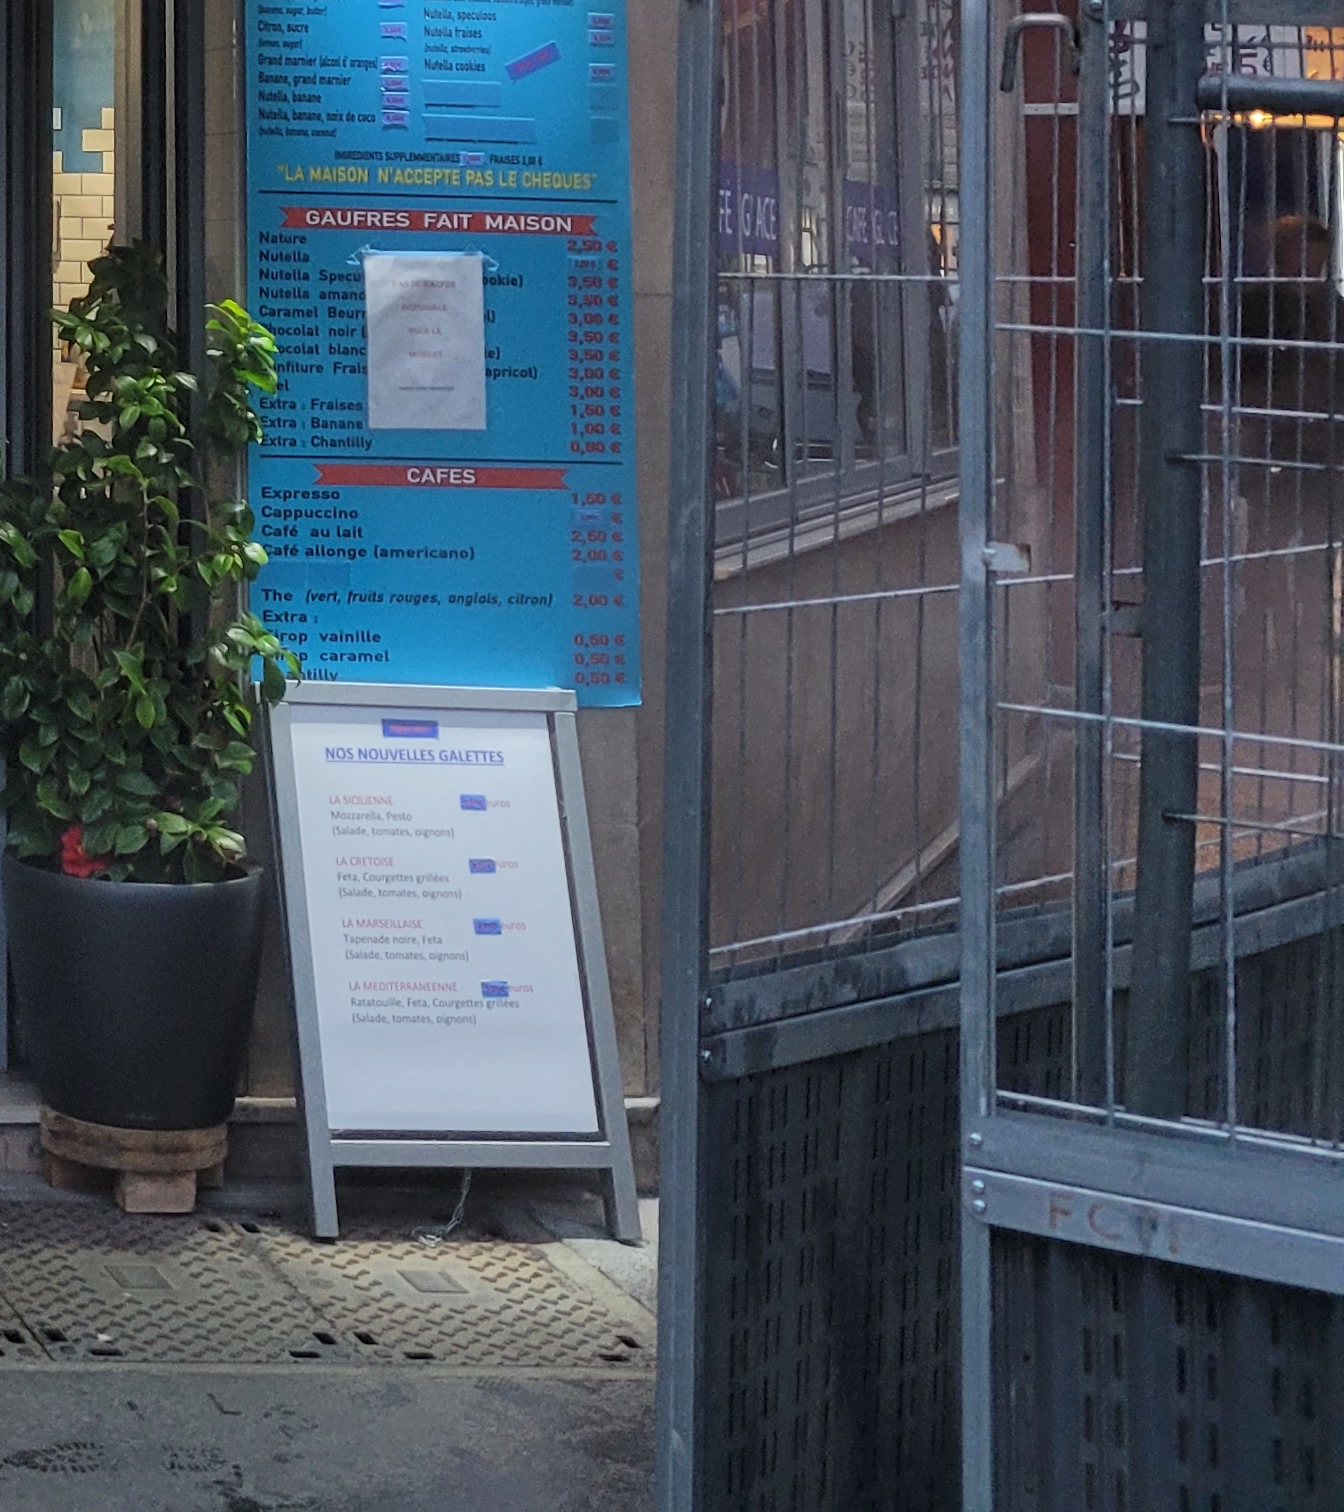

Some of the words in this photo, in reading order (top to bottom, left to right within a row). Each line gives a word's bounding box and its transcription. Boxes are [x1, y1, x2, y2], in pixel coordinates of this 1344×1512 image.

[310, 166, 369, 183] MAISON
[378, 168, 460, 185] N'ACCEPTE
[466, 170, 494, 186] PAS
[499, 172, 518, 187] LE
[305, 210, 410, 227] GAUFRES
[424, 212, 472, 229] FAIT
[485, 215, 572, 232] MAISON
[259, 232, 307, 243] Nature
[259, 250, 310, 262] Nutella
[311, 436, 373, 451] Chantilly
[407, 468, 475, 483] CAFES
[261, 487, 340, 502] Expresso
[261, 506, 358, 521] Cappuccino
[261, 525, 298, 538] Café
[310, 528, 330, 538] au
[336, 525, 363, 538] lait
[305, 546, 367, 561] allonge
[374, 545, 475, 561] (americano)
[261, 589, 293, 602] The
[348, 591, 384, 605] fruits
[508, 593, 553, 608] citron)
[325, 747, 355, 761] NOS
[358, 748, 435, 762] NOUVELLES
[439, 750, 505, 764] GALETTES
